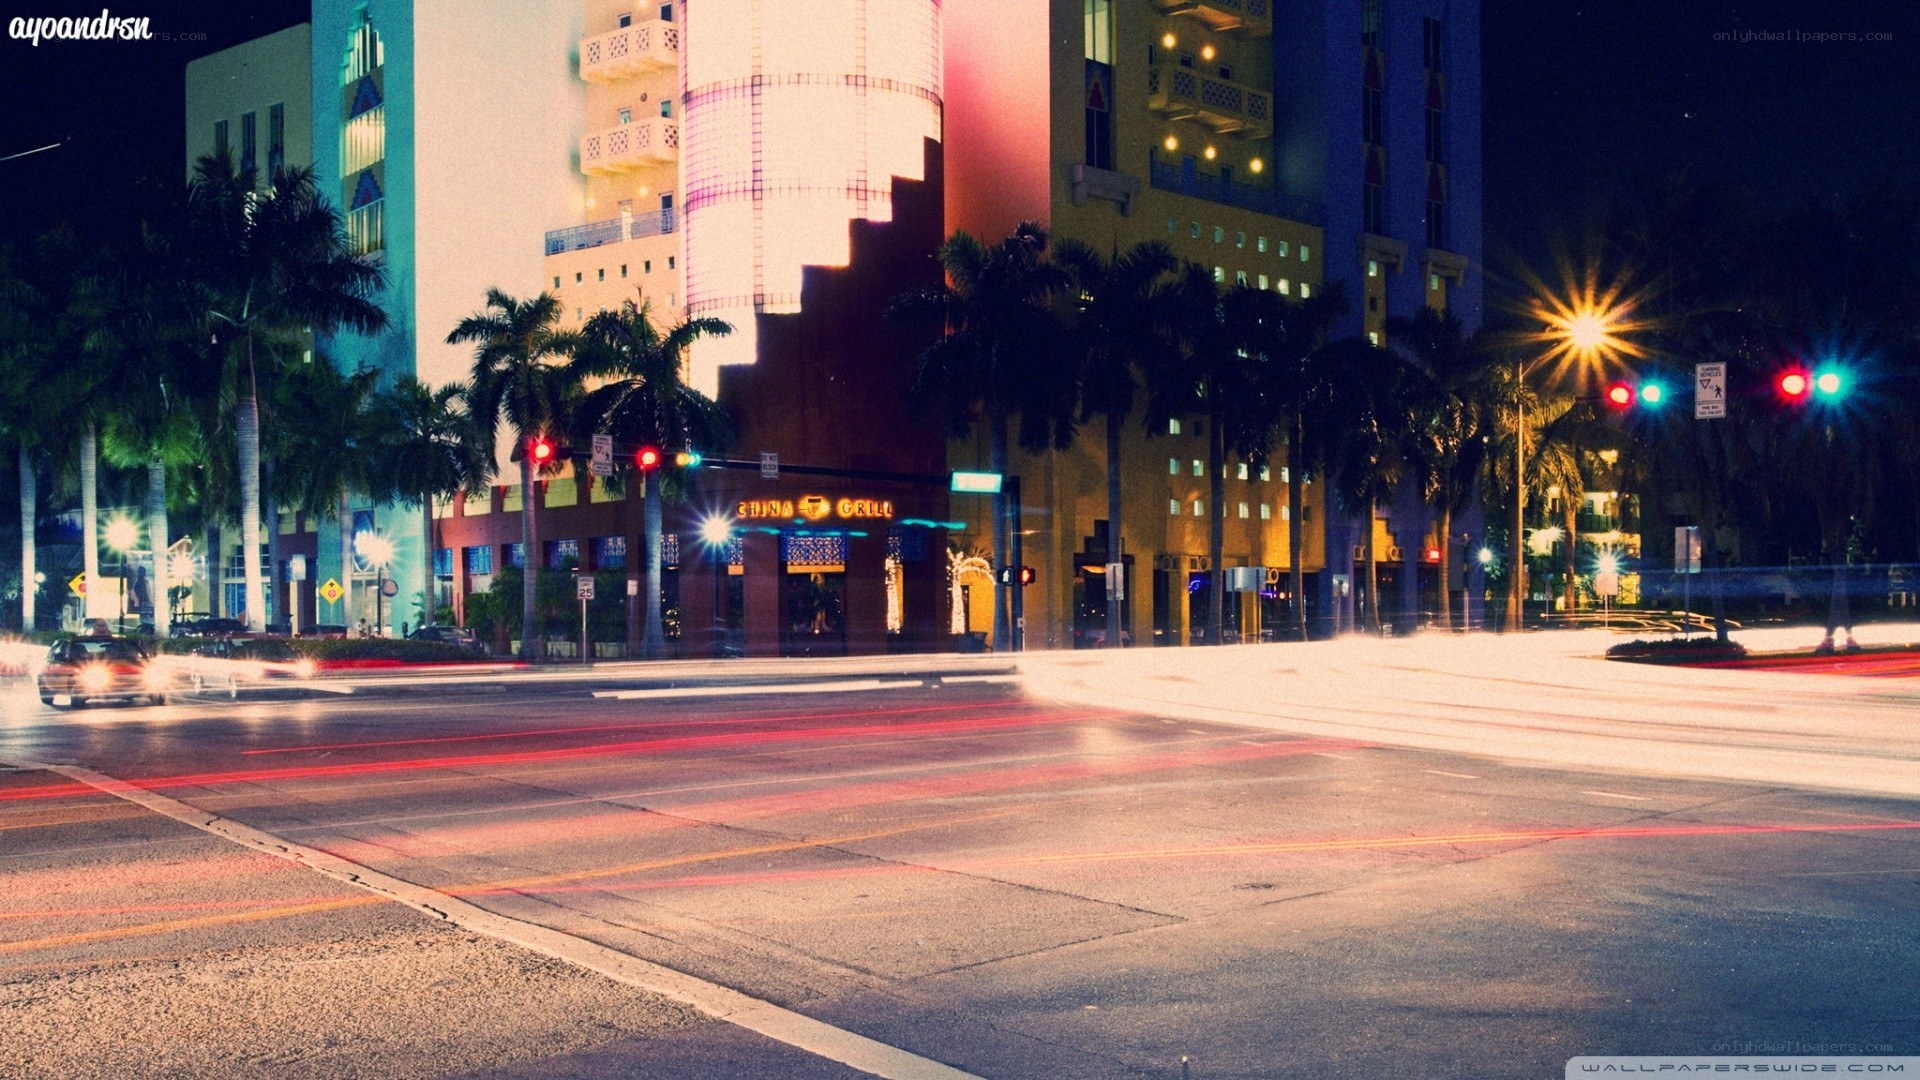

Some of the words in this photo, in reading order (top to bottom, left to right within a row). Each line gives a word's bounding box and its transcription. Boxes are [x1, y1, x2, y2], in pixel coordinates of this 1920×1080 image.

[737, 502, 791, 516] CHINA
[842, 501, 893, 515] GRILL
[579, 588, 593, 597] 25
